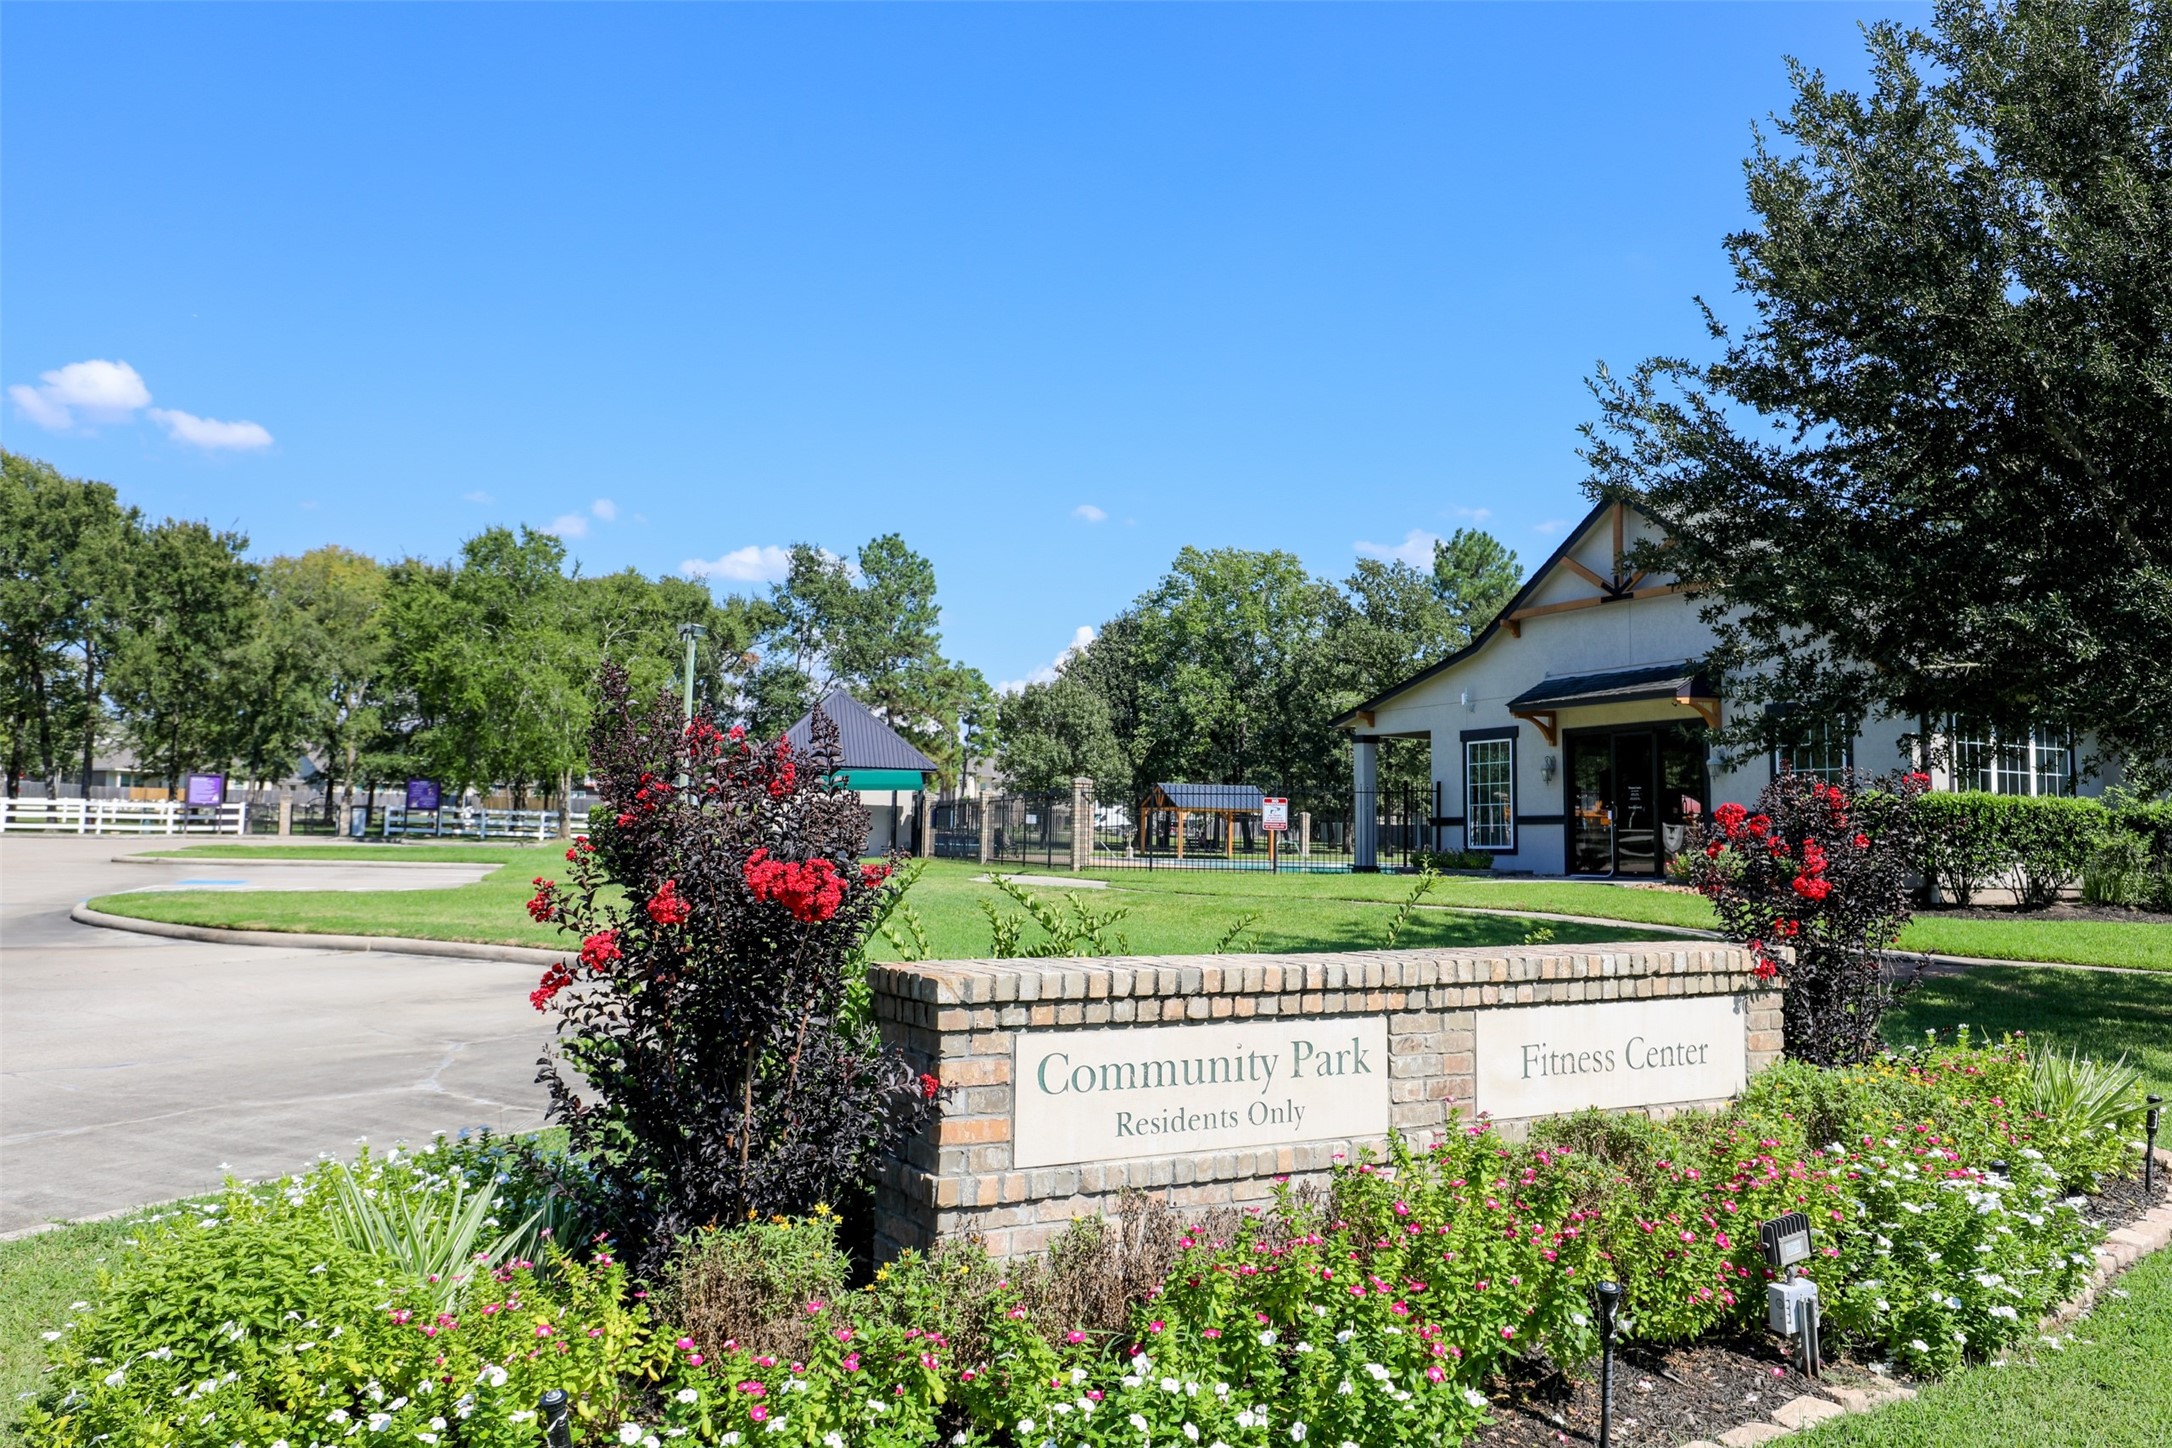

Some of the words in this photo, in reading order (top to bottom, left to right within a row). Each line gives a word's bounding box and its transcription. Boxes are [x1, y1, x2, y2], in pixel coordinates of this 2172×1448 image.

[1037, 1043, 1279, 1096] Community
[1290, 1036, 1373, 1079] Park
[1520, 1042, 1615, 1080] Fitness
[1625, 1036, 1709, 1070] Center
[1116, 1107, 1239, 1138] Residents
[1247, 1098, 1306, 1131] Only
